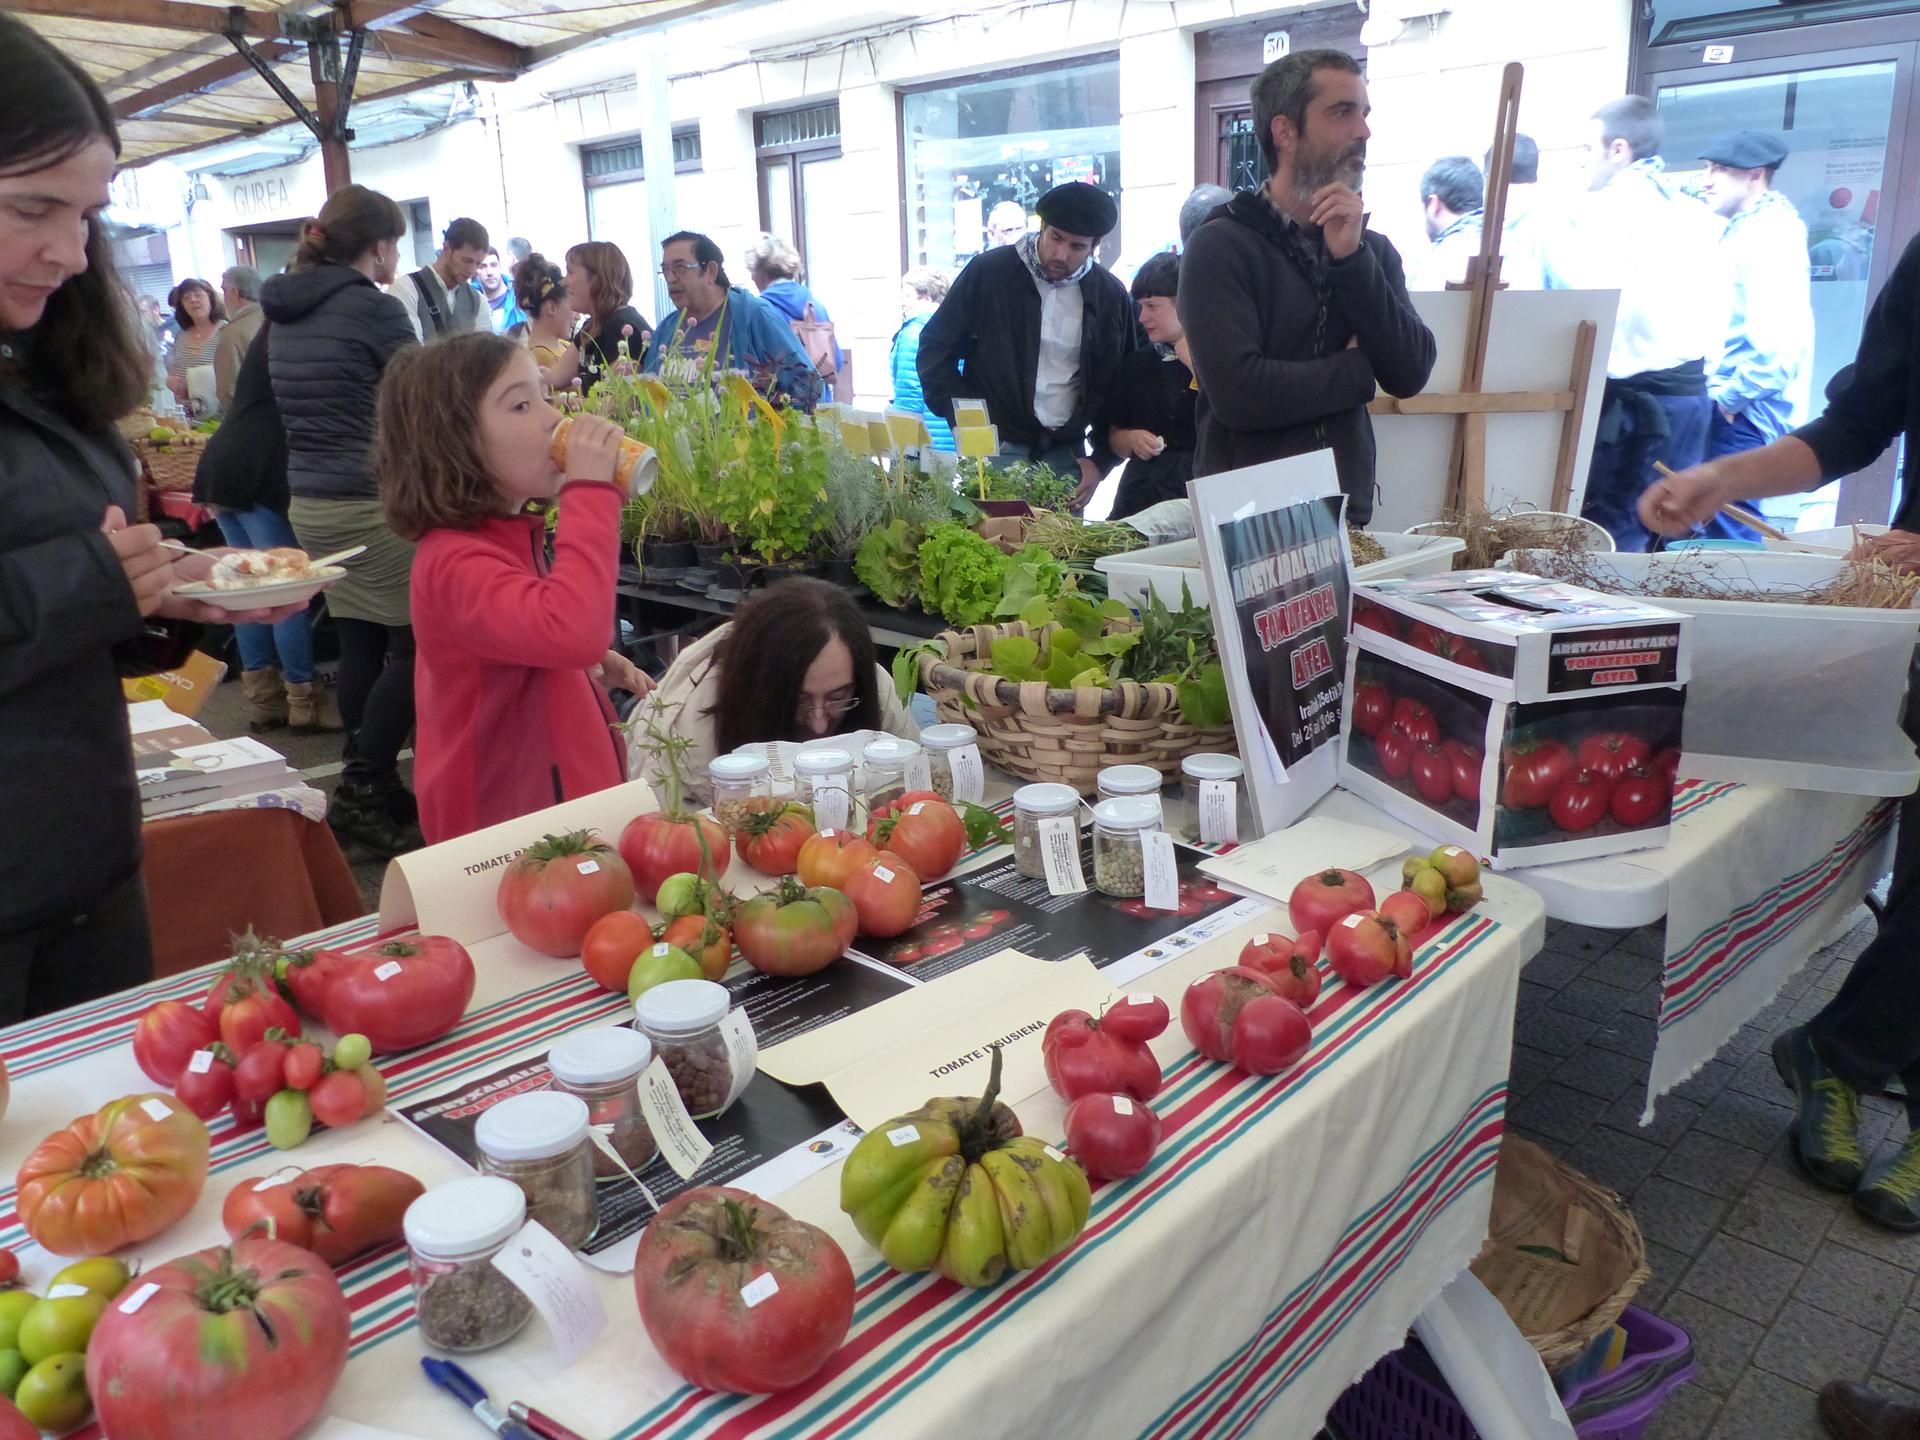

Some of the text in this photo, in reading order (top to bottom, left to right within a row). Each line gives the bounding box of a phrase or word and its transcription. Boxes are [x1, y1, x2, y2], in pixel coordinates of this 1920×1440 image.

[1268, 37, 1284, 54] 30
[233, 178, 289, 216] GUREA
[1551, 635, 1678, 656] ARETXABALETAKO
[1565, 651, 1660, 670] TOMATEAREN
[1591, 669, 1638, 684] ASTEA
[463, 853, 512, 876] TOMATE
[929, 1020, 1048, 1079] TOMATE ITSUSIENA
